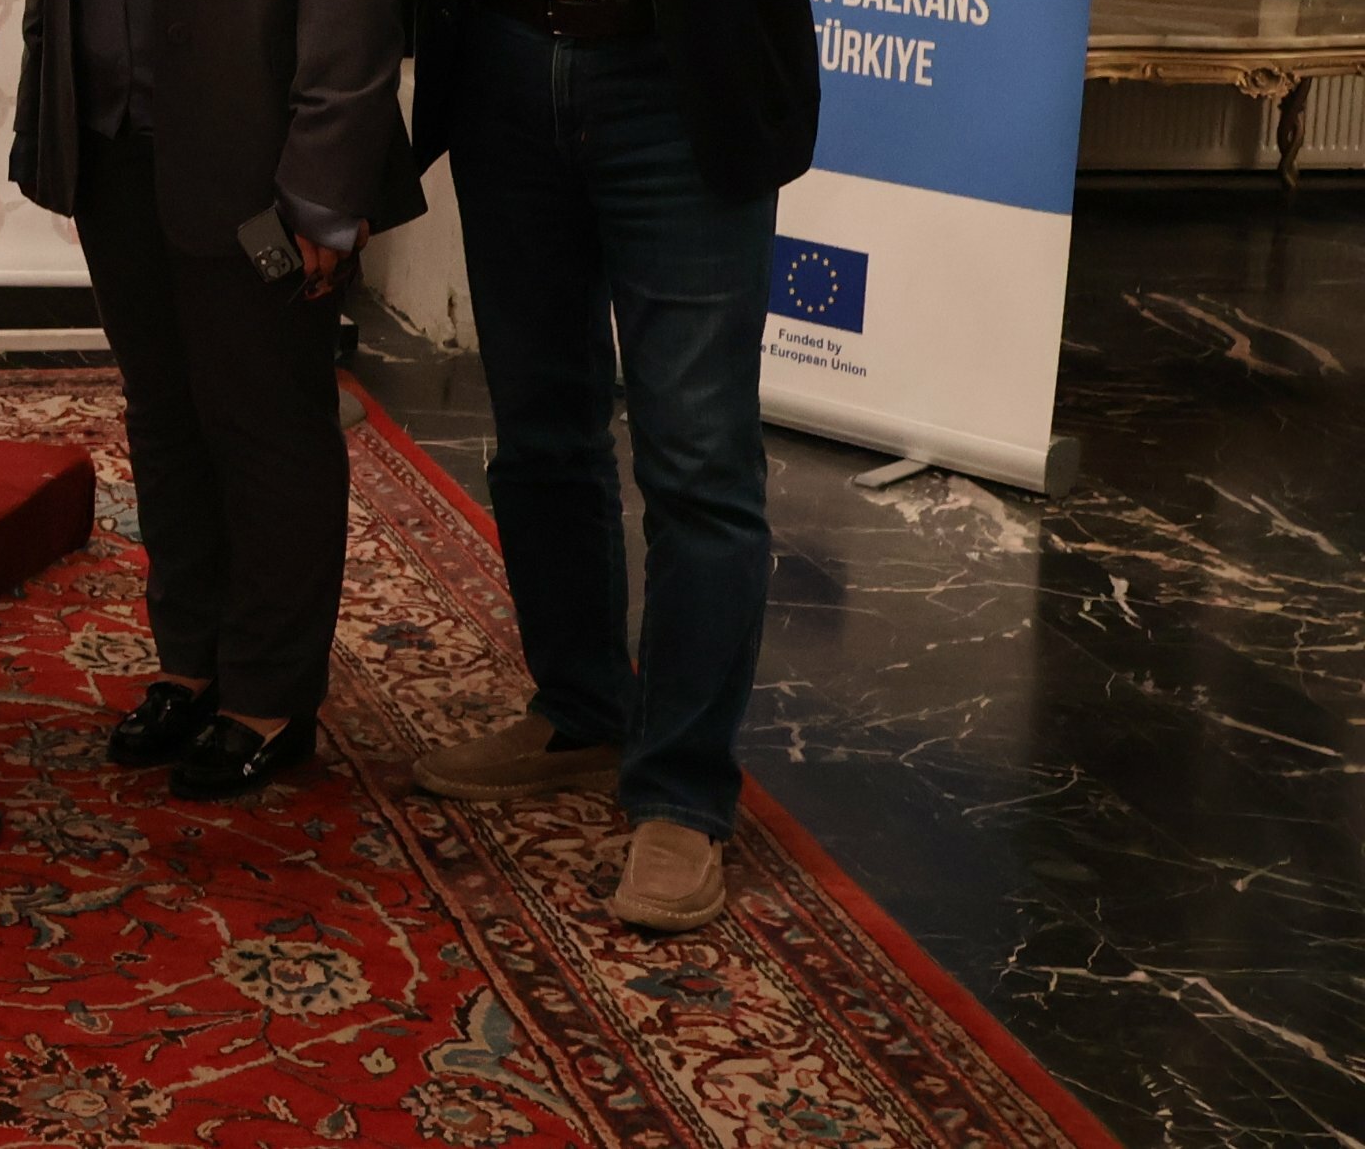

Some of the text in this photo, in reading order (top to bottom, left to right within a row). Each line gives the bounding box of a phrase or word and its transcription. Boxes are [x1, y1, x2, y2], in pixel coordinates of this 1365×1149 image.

[814, 18, 936, 87] ÜRKIYE
[778, 328, 824, 349] Funded
[827, 340, 842, 355] by
[770, 343, 828, 368] European
[831, 357, 867, 377] Union
